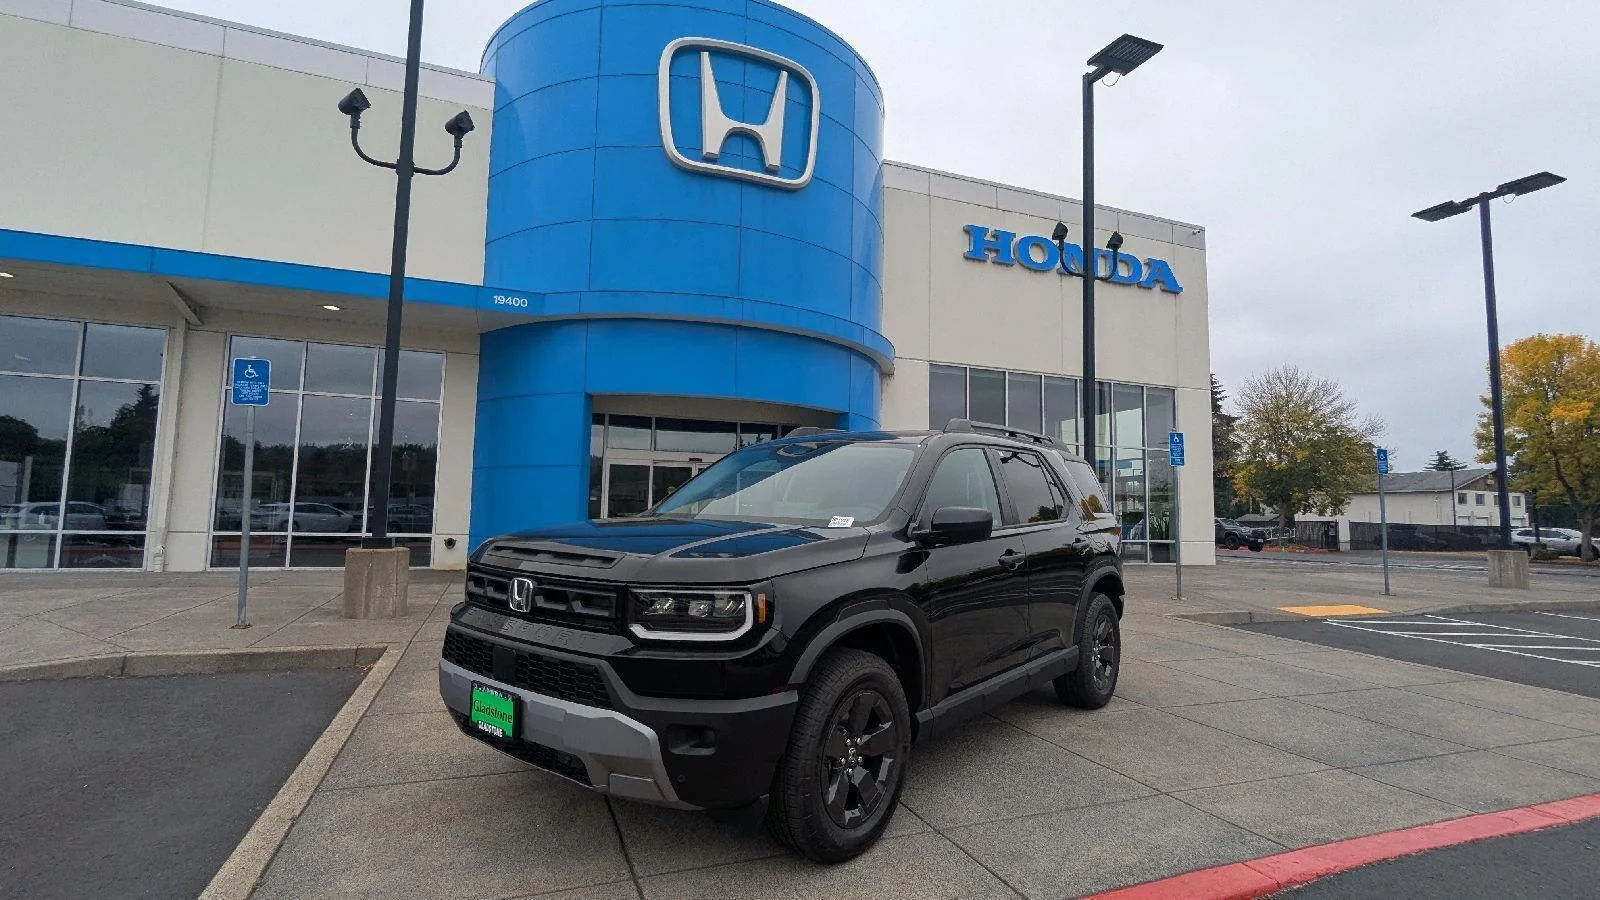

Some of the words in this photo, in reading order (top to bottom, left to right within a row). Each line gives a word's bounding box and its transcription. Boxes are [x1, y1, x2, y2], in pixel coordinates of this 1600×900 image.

[963, 224, 1183, 294] HONDA
[493, 295, 528, 308] 19400
[473, 699, 513, 723] Gladstone
